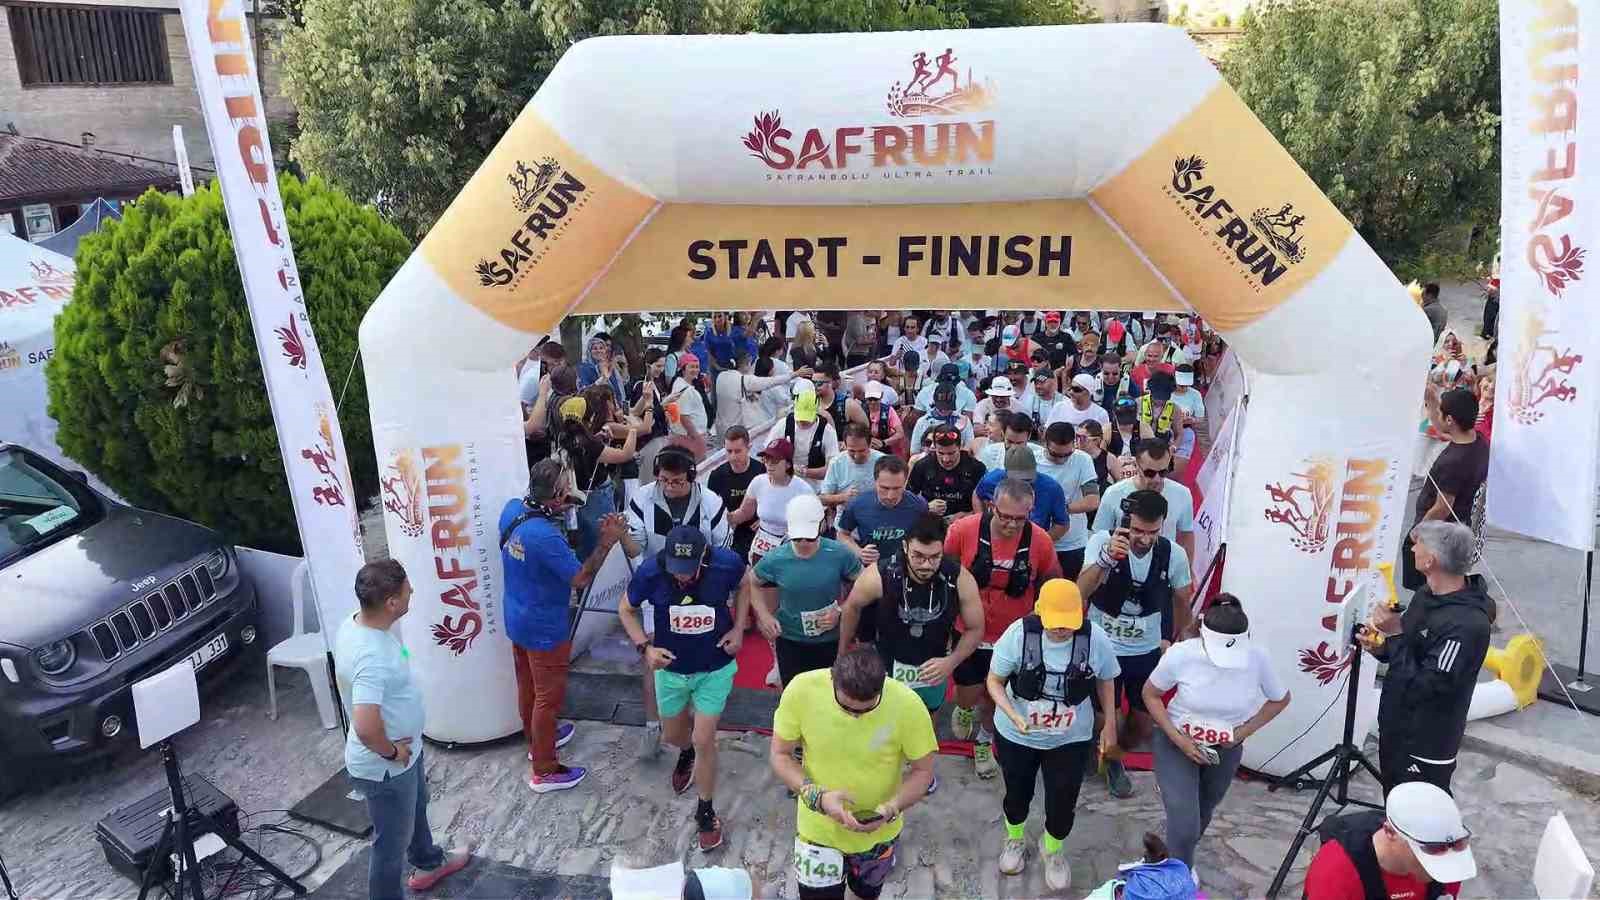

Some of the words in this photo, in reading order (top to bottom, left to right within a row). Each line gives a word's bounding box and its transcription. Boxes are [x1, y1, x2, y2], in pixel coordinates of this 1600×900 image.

[764, 119, 995, 170] SAFRUN
[766, 173, 870, 182] SAFRANBOLU
[883, 170, 933, 180] ULTRA
[945, 168, 994, 177] TRAIL
[488, 171, 586, 286] SAFRUN
[1171, 167, 1288, 286] SAFRUN
[687, 237, 848, 280] START
[862, 255, 881, 265] -
[898, 234, 1072, 277] FINISH
[467, 441, 481, 483] TRAIL
[472, 494, 485, 537] ULTRA
[420, 446, 483, 636] SAFRUN
[131, 575, 156, 592] Jeep
[478, 547, 497, 635] SAFRANBOLU
[673, 615, 713, 628] 1286
[1104, 622, 1145, 639] 2152
[895, 669, 923, 683] 20
[1030, 711, 1074, 728] 1277
[1182, 723, 1230, 745] 1288
